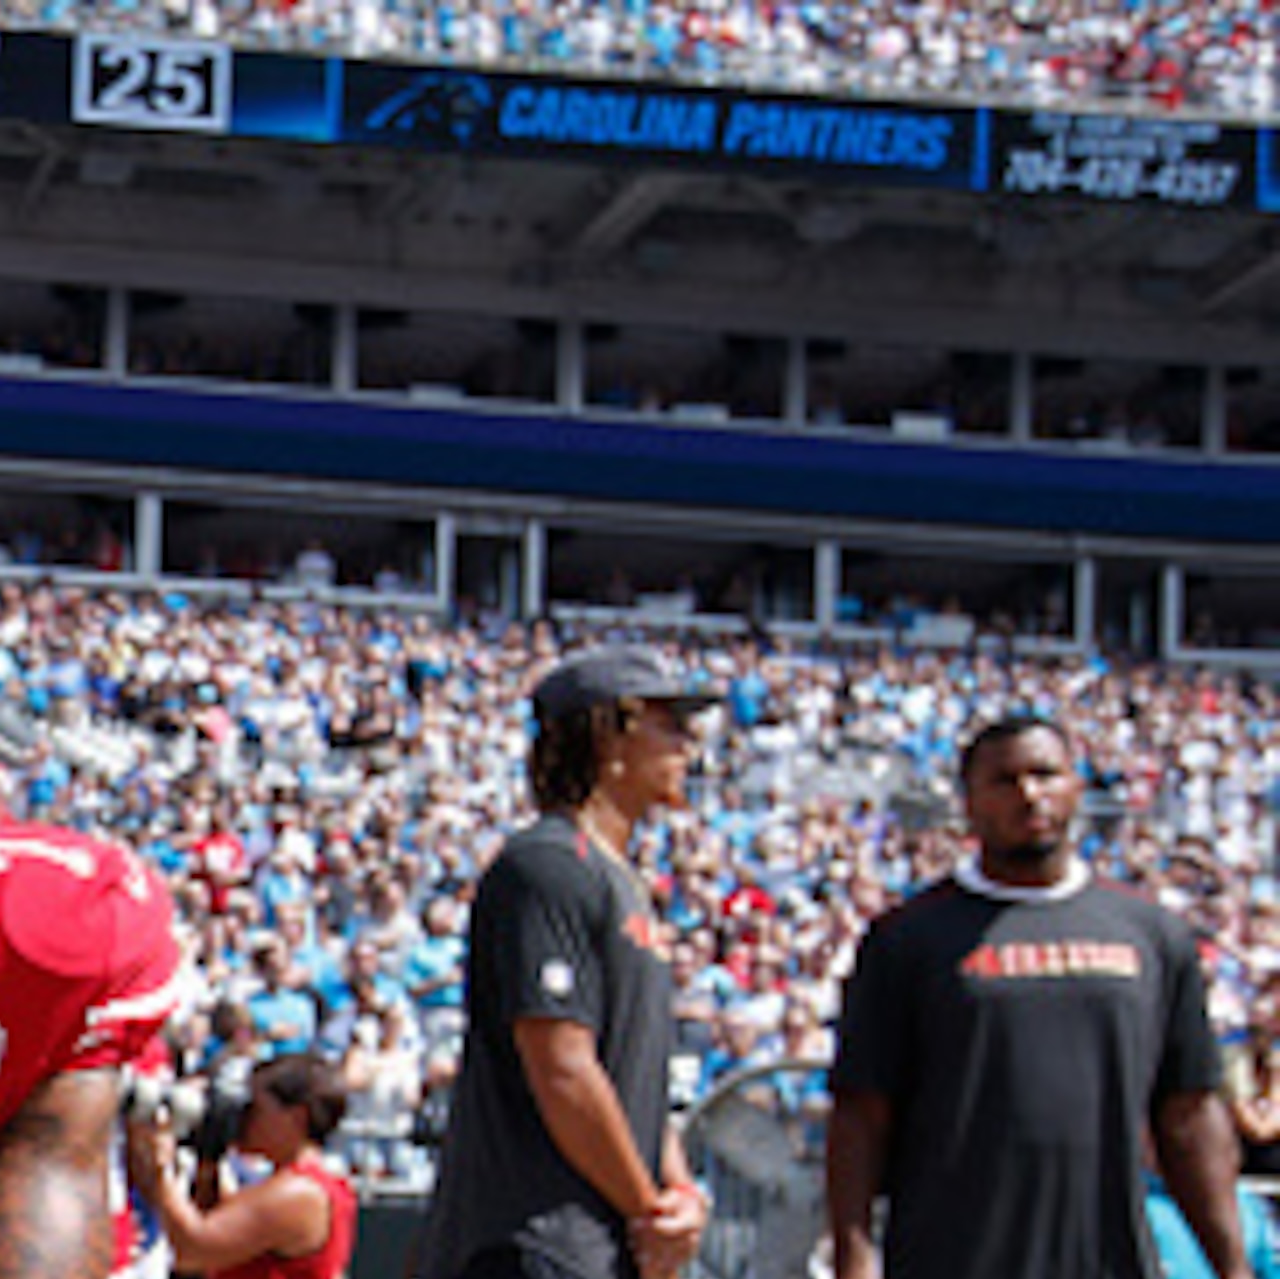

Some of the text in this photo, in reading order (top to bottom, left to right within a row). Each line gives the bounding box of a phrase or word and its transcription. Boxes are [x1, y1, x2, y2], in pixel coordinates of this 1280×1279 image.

[97, 46, 205, 117] 25
[498, 86, 718, 152] CAROLINA
[722, 102, 953, 169] PANTHERS
